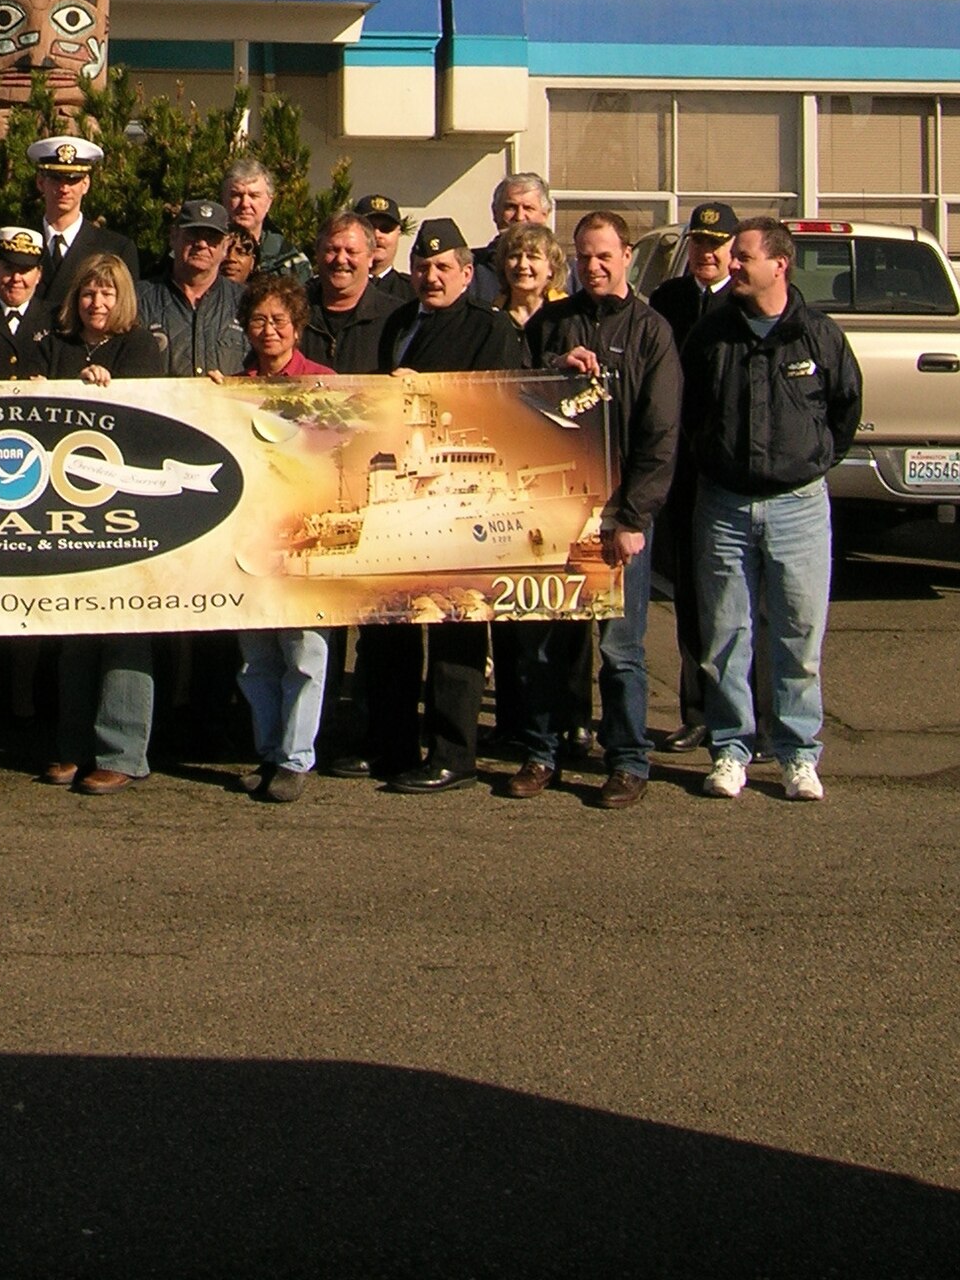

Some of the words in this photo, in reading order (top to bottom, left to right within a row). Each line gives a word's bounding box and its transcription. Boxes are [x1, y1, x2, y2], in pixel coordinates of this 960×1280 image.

[488, 518, 524, 533] NOAA
[38, 538, 52, 550] &
[58, 537, 159, 551] Stewardship
[491, 574, 587, 612] 2007
